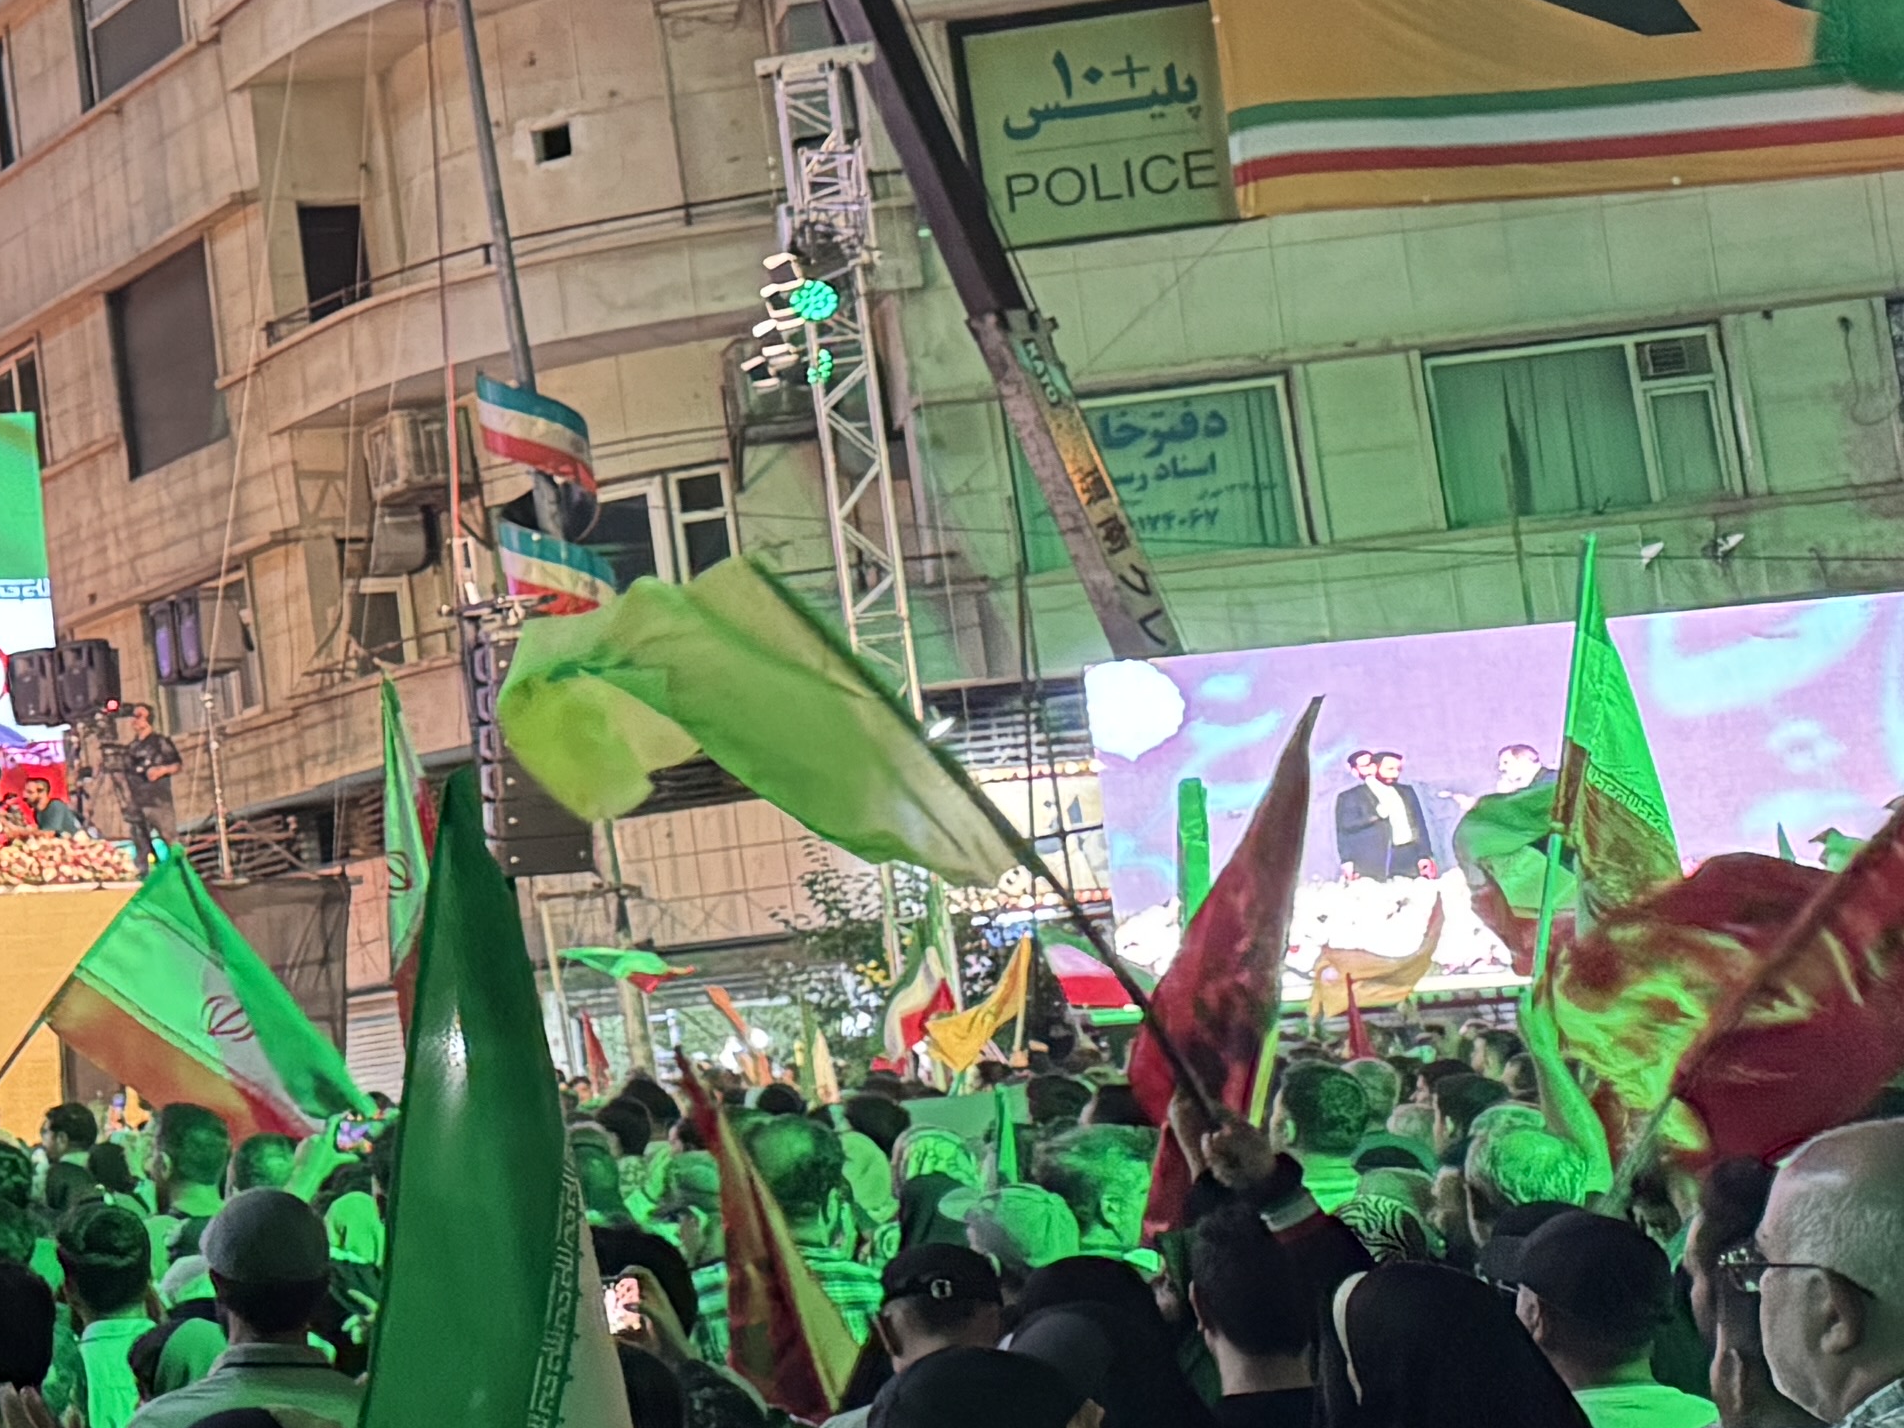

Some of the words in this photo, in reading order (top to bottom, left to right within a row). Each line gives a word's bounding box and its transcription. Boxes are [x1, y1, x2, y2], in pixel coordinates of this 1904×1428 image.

[1003, 62, 1202, 141] پلیس
[1005, 148, 1221, 214] POLICE
[1099, 401, 1229, 459] دفترخا
